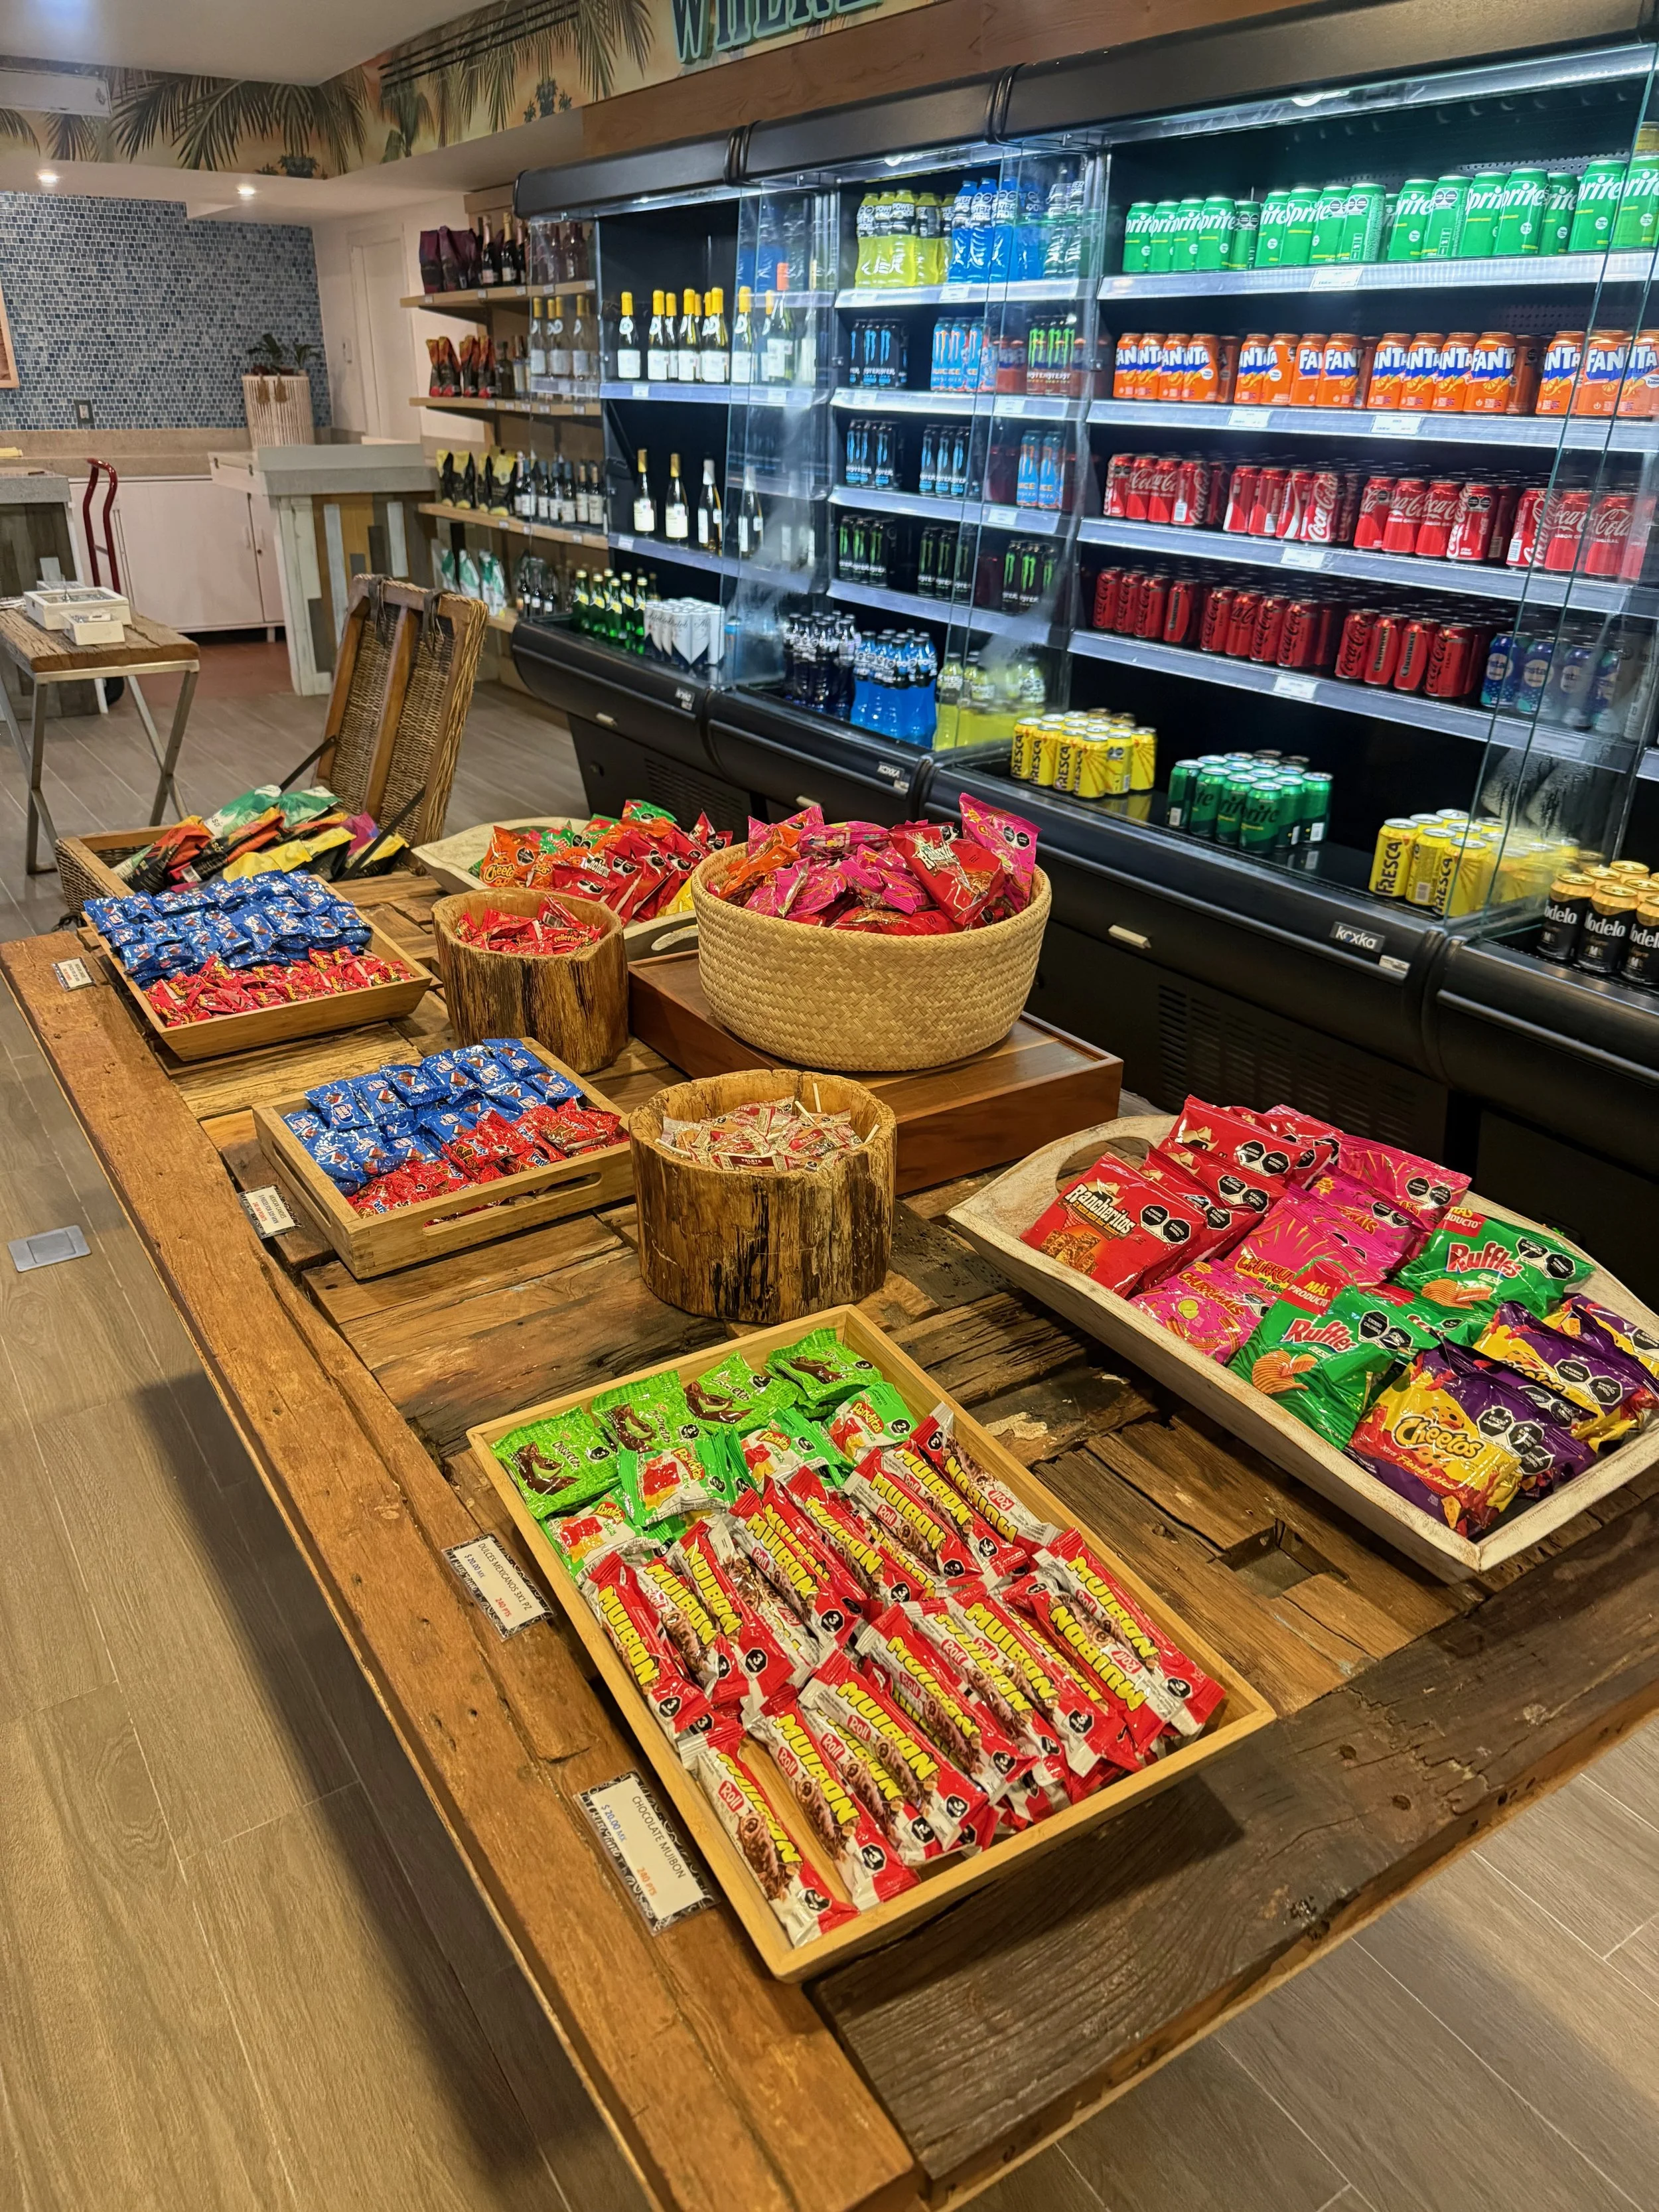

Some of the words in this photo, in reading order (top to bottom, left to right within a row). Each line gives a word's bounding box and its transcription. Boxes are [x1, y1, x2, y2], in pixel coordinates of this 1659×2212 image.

[1375, 841, 1402, 895] FRESCA
[1544, 905, 1577, 924] odelo
[1334, 925, 1378, 950] koxka
[529, 1151, 550, 1167] Kran
[1065, 1183, 1137, 1234] Rancheritos
[1447, 1241, 1524, 1278] Ruffles
[1303, 1281, 1331, 1297] MÁS
[1282, 1318, 1359, 1353] Ruffles
[852, 1402, 884, 1434] Panditas
[759, 1431, 792, 1450] Panditas
[1393, 1414, 1484, 1459] Cheetos
[675, 1448, 705, 1480] Panditas
[894, 1448, 972, 1525] MUIBON
[944, 1457, 1018, 1543] MUIBON
[596, 1504, 626, 1523] Panditas
[870, 1471, 948, 1550] MUIBON
[878, 1505, 896, 1525] Roll
[467, 1557, 481, 1571] 20.00
[745, 1512, 820, 1601] MUIBON
[478, 1543, 496, 1562] DULCES
[492, 1561, 519, 1592] MEXICANOS
[514, 1589, 526, 1603] 3X1
[522, 1601, 532, 1611] PZ
[682, 1542, 744, 1636] MUIBON
[495, 1597, 506, 1609] 240
[502, 1607, 512, 1617] PTS
[645, 1563, 719, 1646] MUIBON
[1067, 1556, 1161, 1658] MUIBON
[1077, 1590, 1097, 1615] Roll
[598, 1585, 661, 1686] MUIBON
[964, 1602, 1060, 1700] MUIBON
[935, 1613, 1034, 1713] MUIBON
[943, 1641, 968, 1663] Roll
[1049, 1605, 1149, 1712] MUIBON
[1112, 1650, 1141, 1674] Roll
[901, 1673, 920, 1698] Roll
[837, 1680, 940, 1781] MUIBON
[849, 1717, 871, 1737] Roll
[779, 1749, 798, 1776] Roll
[822, 1735, 845, 1759] Roll
[774, 1713, 861, 1825] MUIBON
[721, 1783, 743, 1811] Roll
[605, 1808, 621, 1830] 20.00
[632, 1795, 664, 1843] CHOCOLATE
[659, 1840, 686, 1879] MUIBON
[636, 1866, 650, 1884] 240
[644, 1880, 658, 1897] PTS
